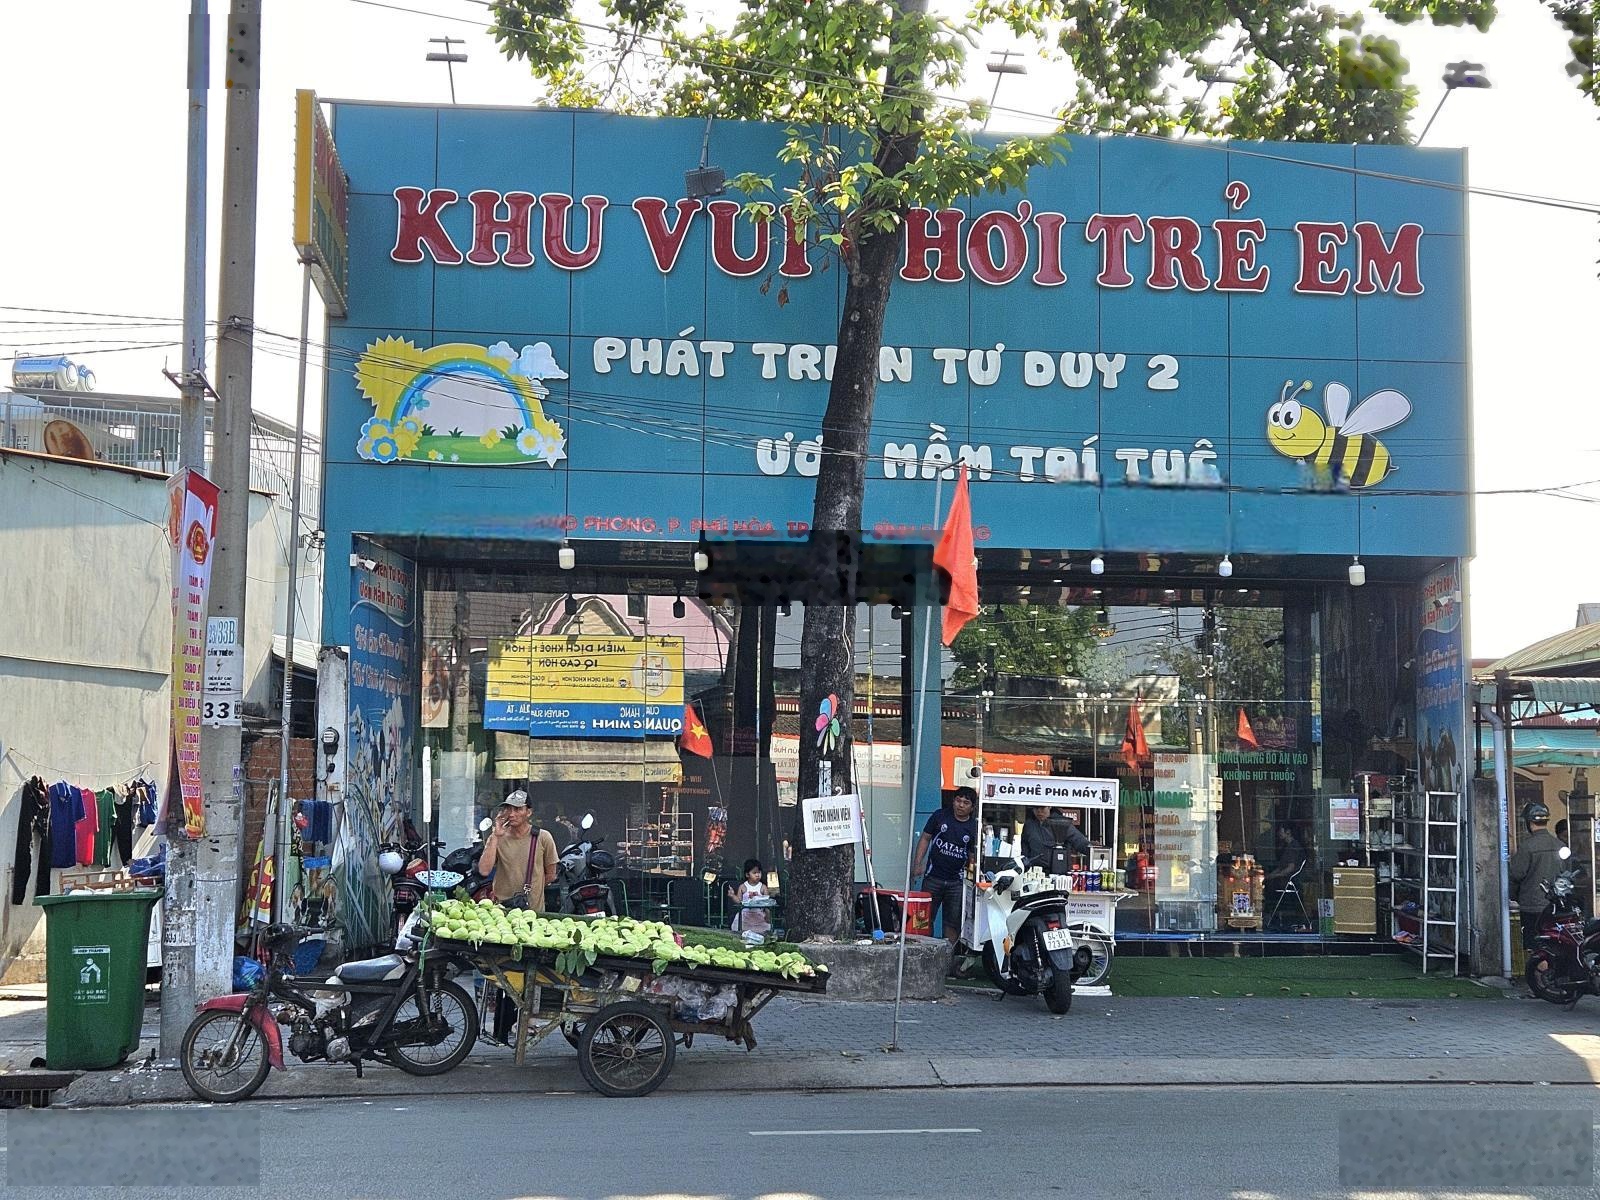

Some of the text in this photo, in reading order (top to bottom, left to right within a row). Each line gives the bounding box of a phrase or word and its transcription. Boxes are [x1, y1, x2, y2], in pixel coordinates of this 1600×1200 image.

[390, 186, 609, 271] KHU
[632, 195, 812, 278] VUI
[841, 200, 1067, 287] HƠI
[1085, 180, 1271, 294] TRẺ
[1294, 221, 1426, 297] EM
[594, 325, 1180, 390] PHÁT TRIN TƯ DUY 2
[756, 432, 824, 477] ƯƠ
[883, 423, 993, 482] MẦM
[999, 782, 1098, 798] CÀ PHÊ PHA MÁY
